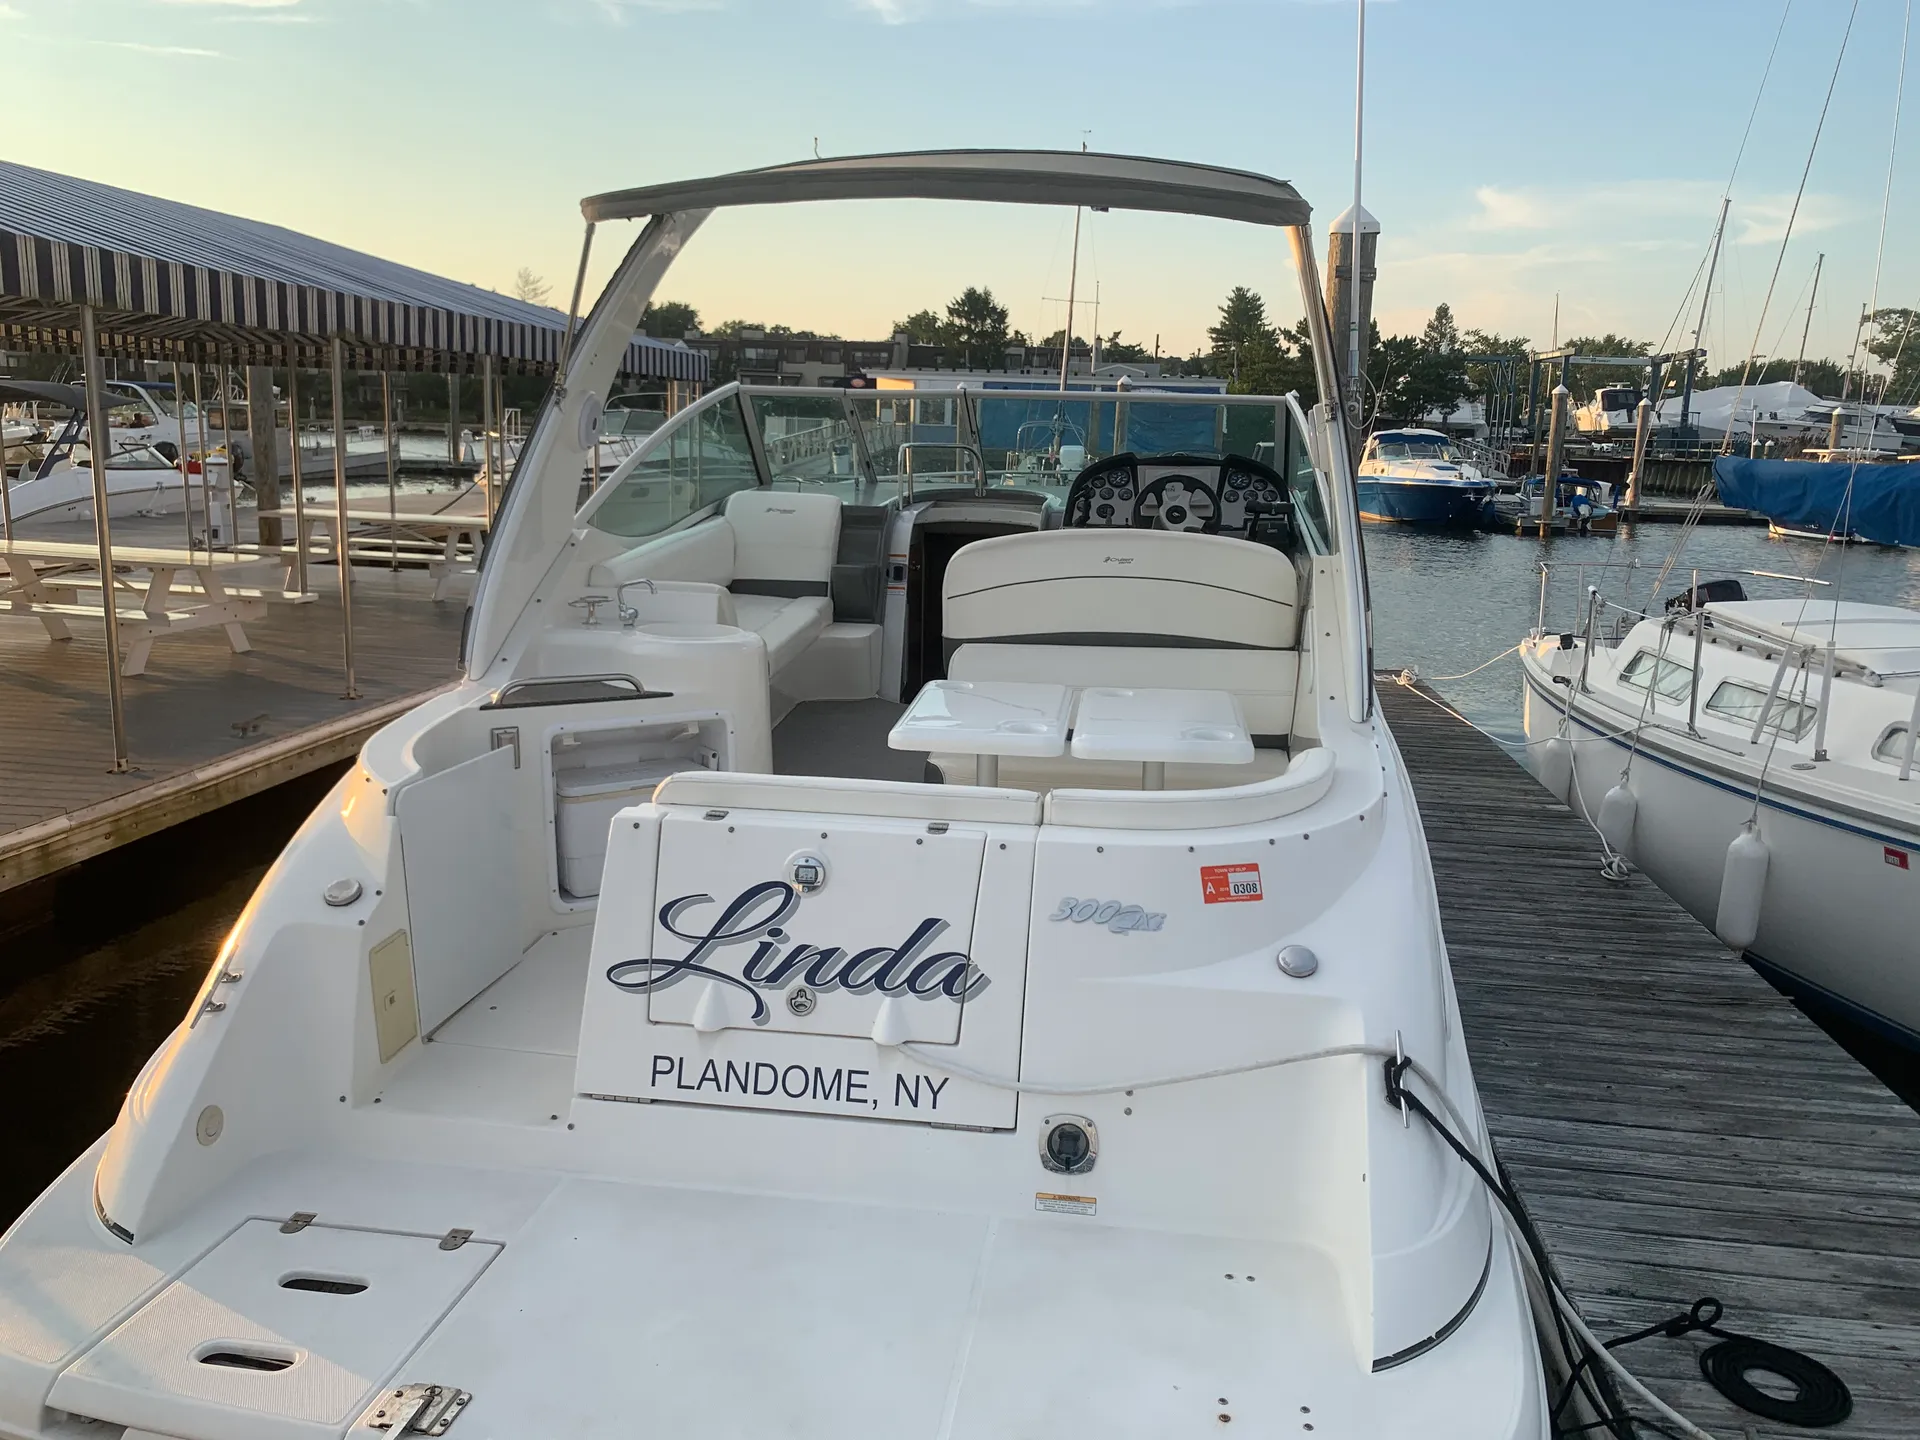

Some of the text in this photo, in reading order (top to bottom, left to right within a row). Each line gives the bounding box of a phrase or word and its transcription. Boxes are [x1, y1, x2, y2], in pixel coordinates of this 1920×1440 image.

[1206, 882, 1216, 895] A
[1233, 883, 1258, 895] 0308
[606, 880, 992, 1027] Linda
[651, 1055, 950, 1111] PLANDOME, NY
